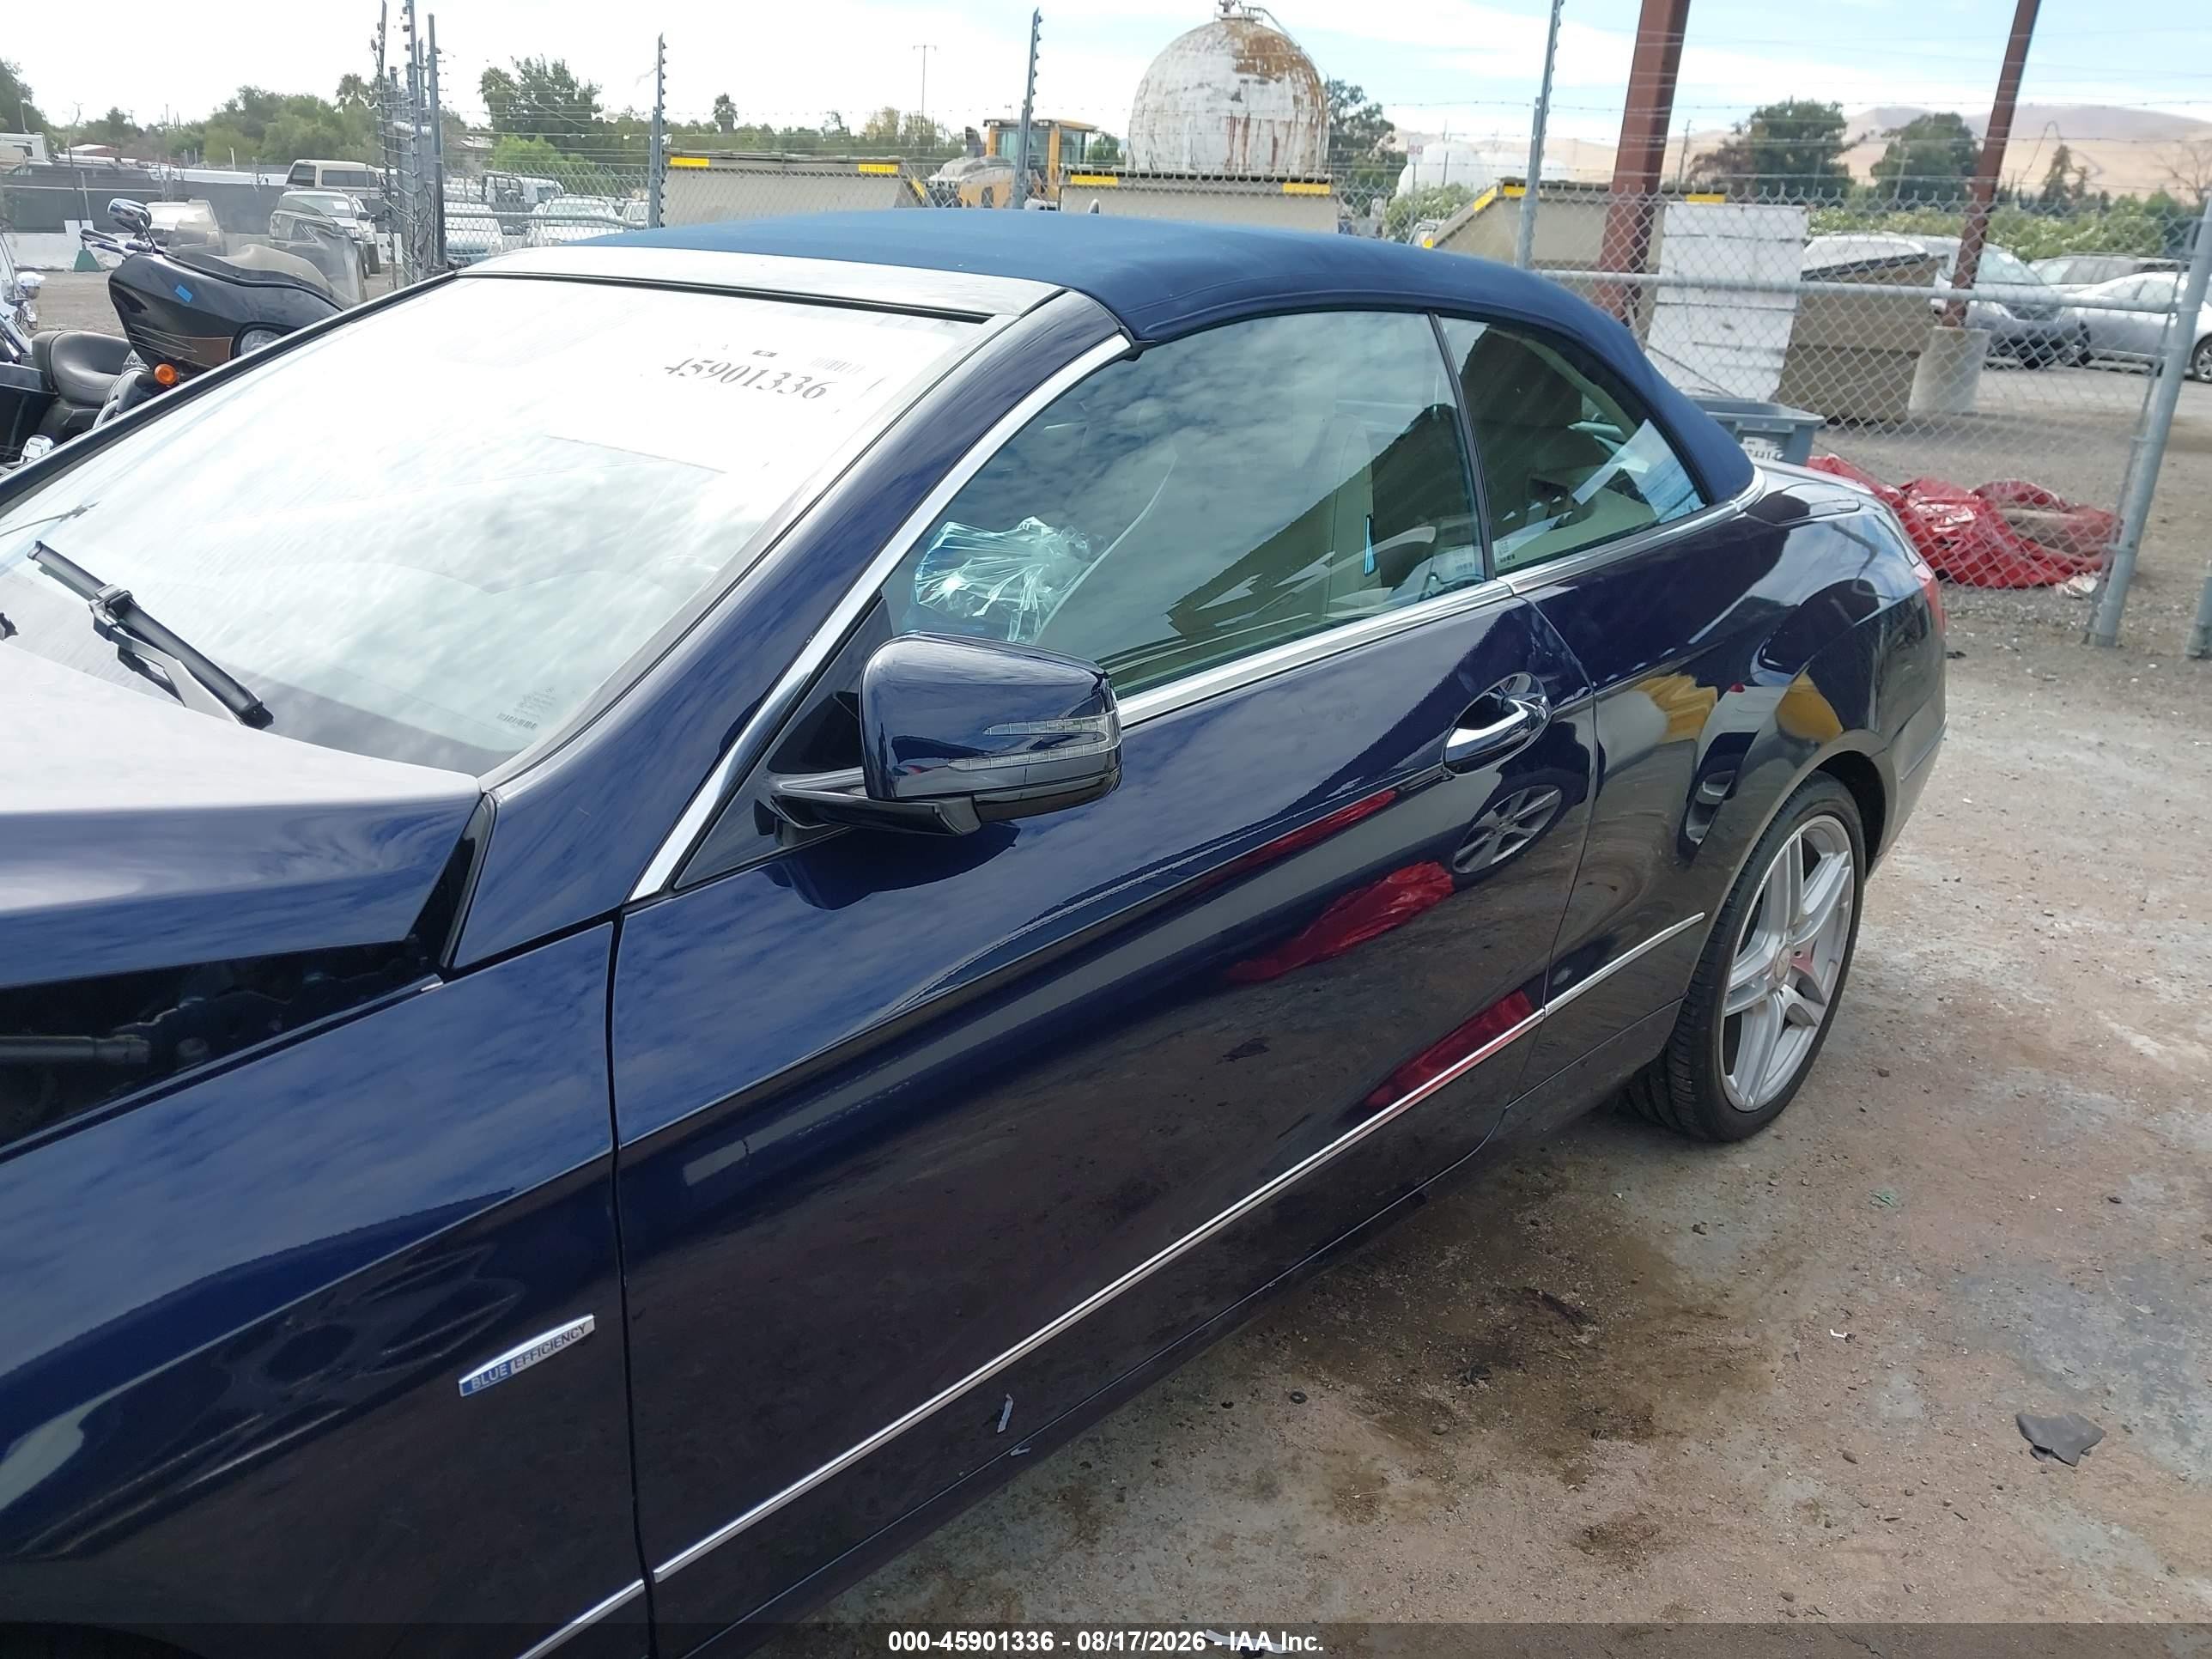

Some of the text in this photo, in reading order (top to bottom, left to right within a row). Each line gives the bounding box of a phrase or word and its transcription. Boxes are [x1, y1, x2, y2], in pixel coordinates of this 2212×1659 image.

[664, 357, 838, 399] 45901336
[471, 1322, 586, 1390] BLUE EFFICIENCY
